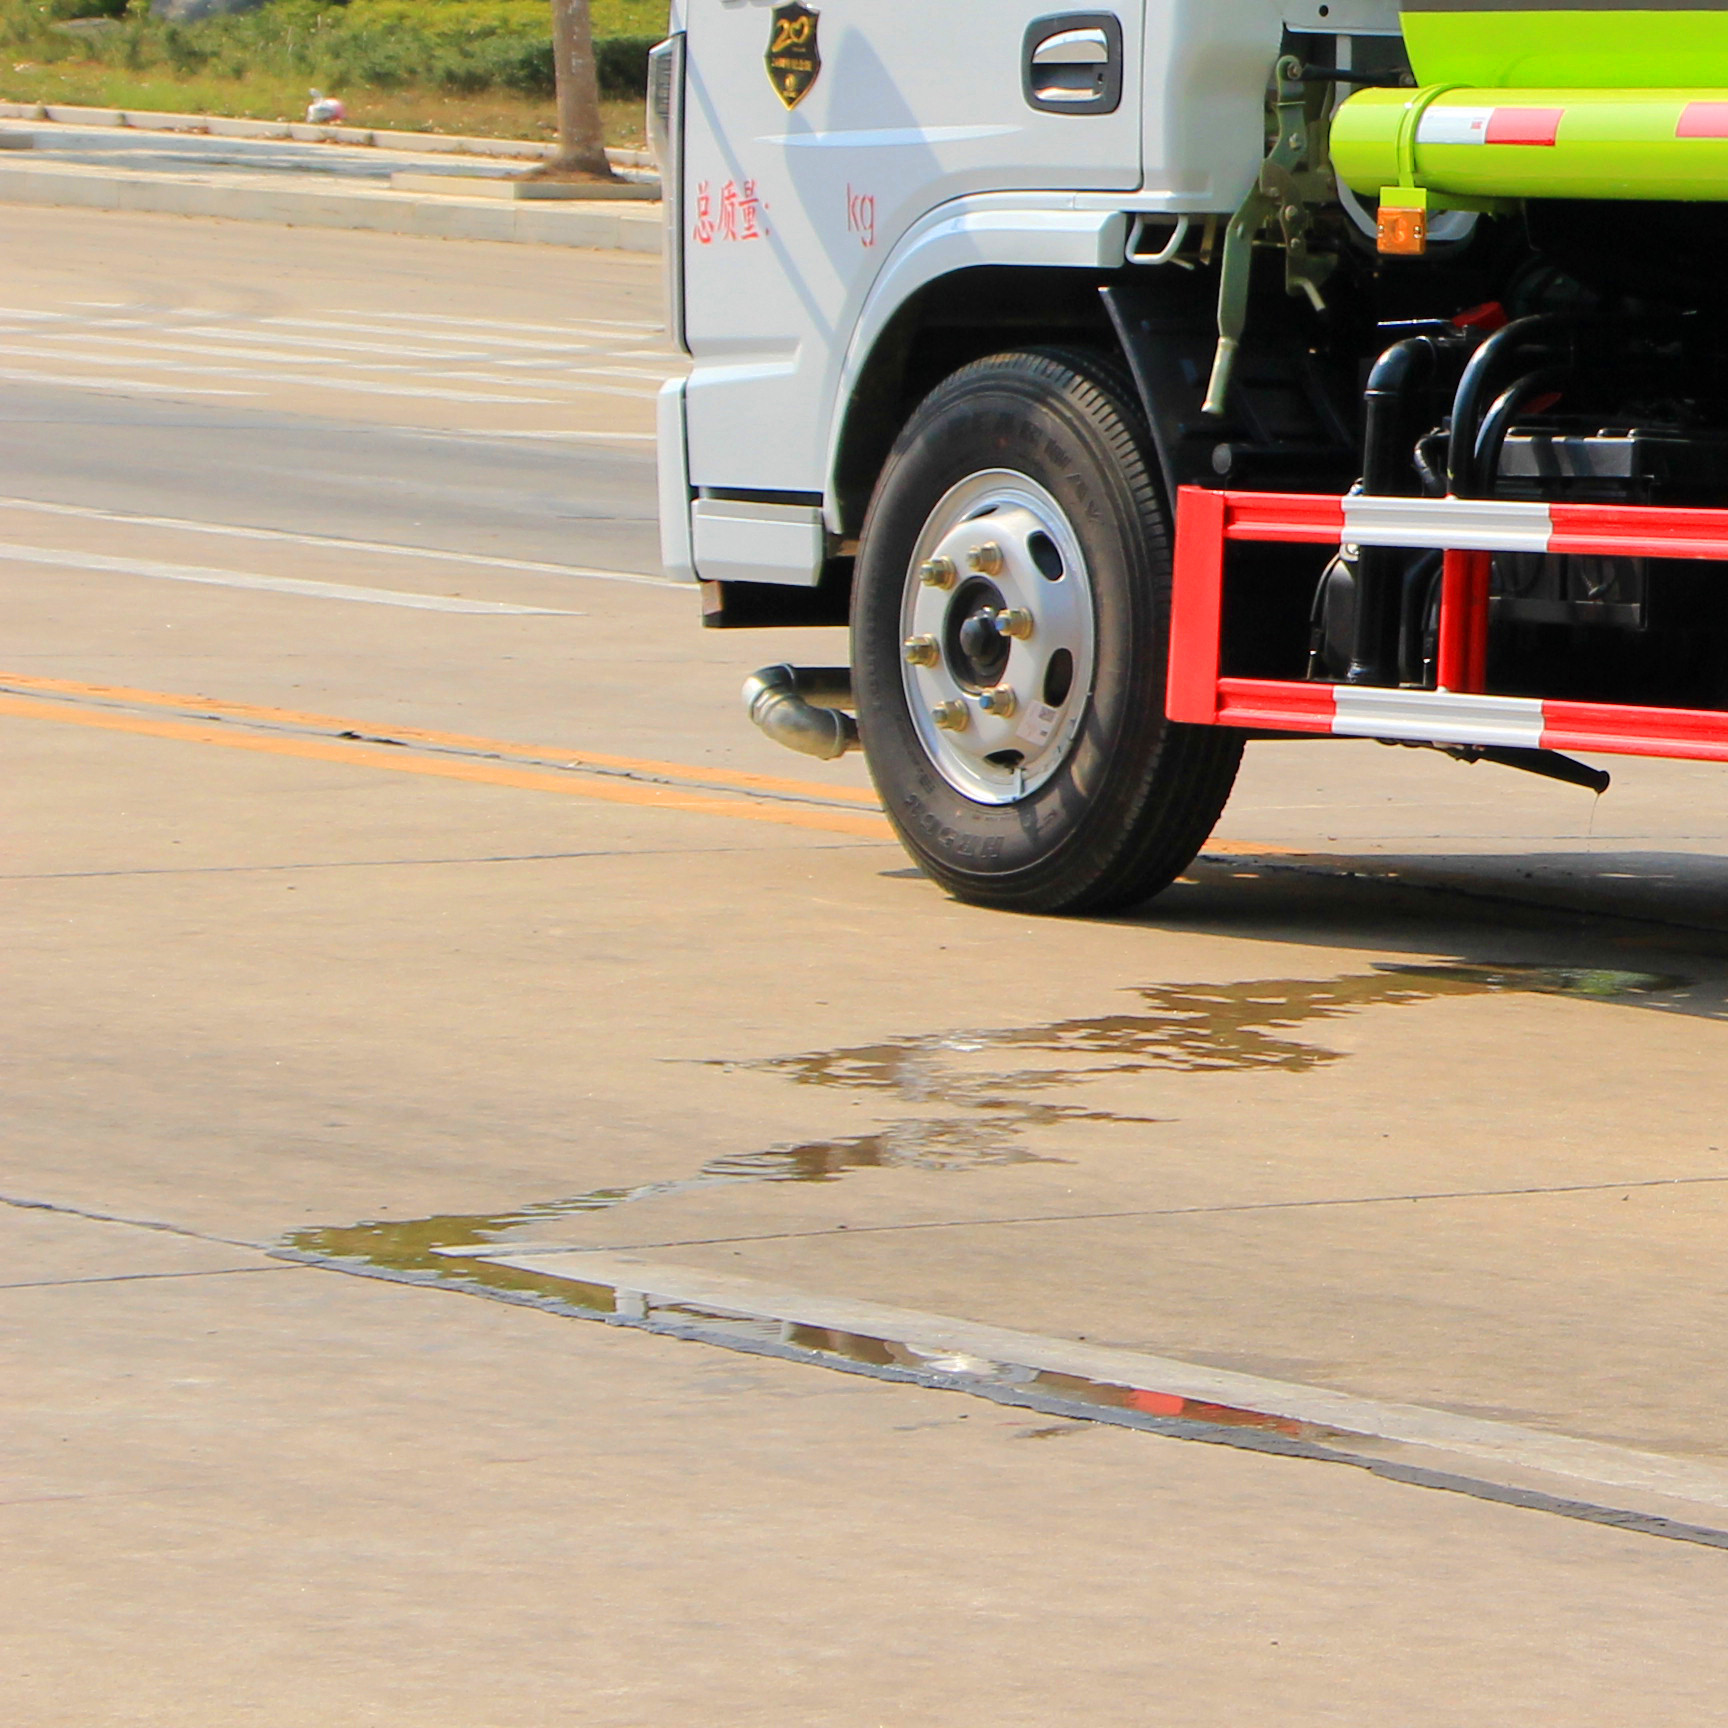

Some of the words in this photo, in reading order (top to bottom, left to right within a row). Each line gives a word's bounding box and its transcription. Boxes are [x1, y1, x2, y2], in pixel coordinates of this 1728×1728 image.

[772, 15, 810, 53] 20
[693, 179, 770, 244] 总质量:
[847, 182, 875, 247] kg
